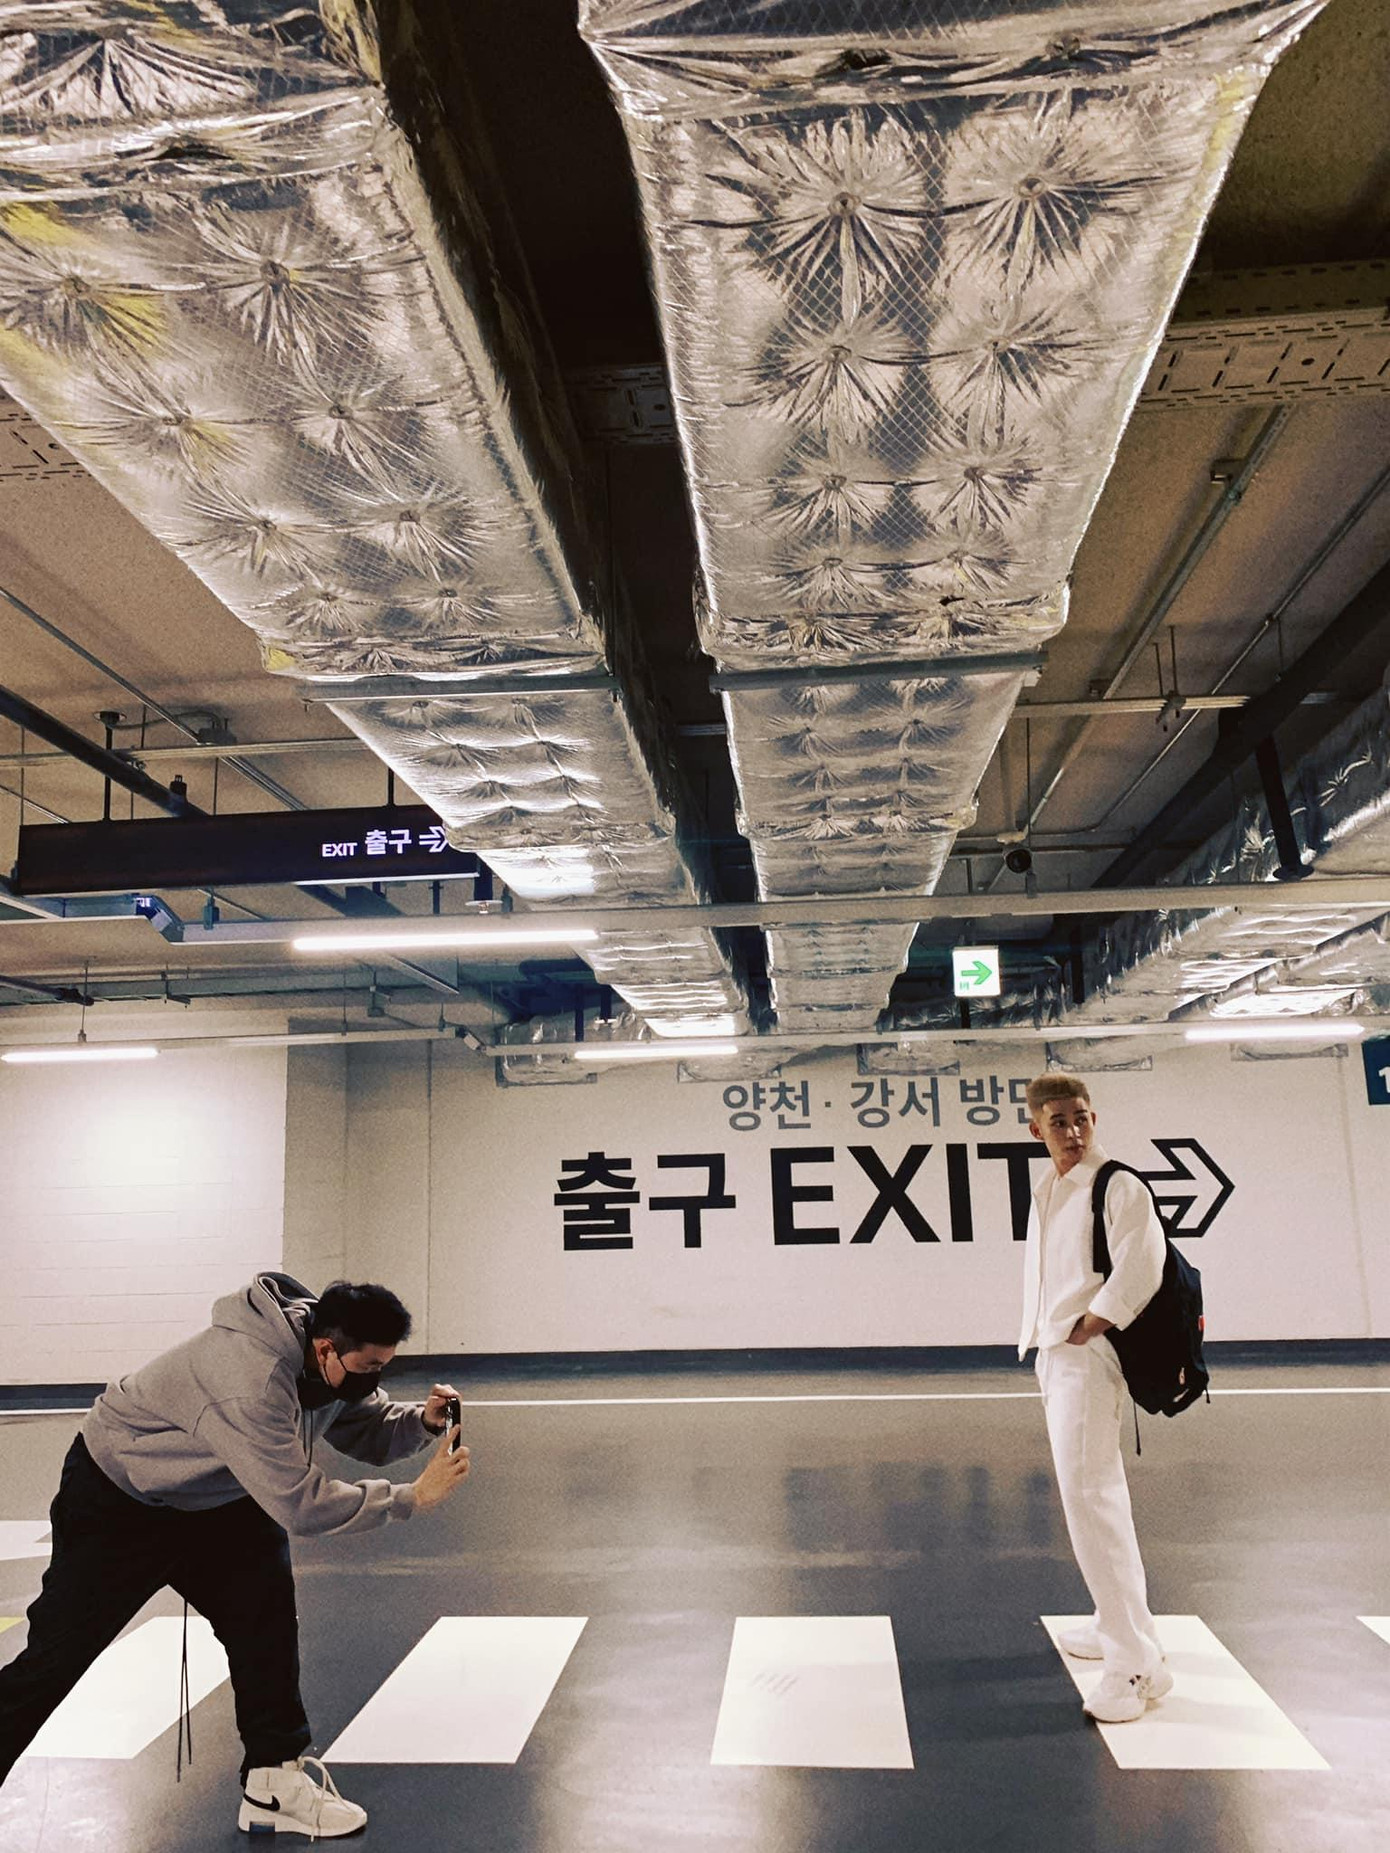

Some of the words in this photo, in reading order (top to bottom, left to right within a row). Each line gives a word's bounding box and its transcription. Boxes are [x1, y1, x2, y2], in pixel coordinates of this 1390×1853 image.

[322, 842, 357, 857] EXIT
[365, 829, 412, 855] 출구
[722, 1080, 811, 1131] 양천
[850, 1077, 941, 1128] 강서
[554, 1151, 736, 1251] 출구
[770, 1142, 1052, 1246] EXIT
